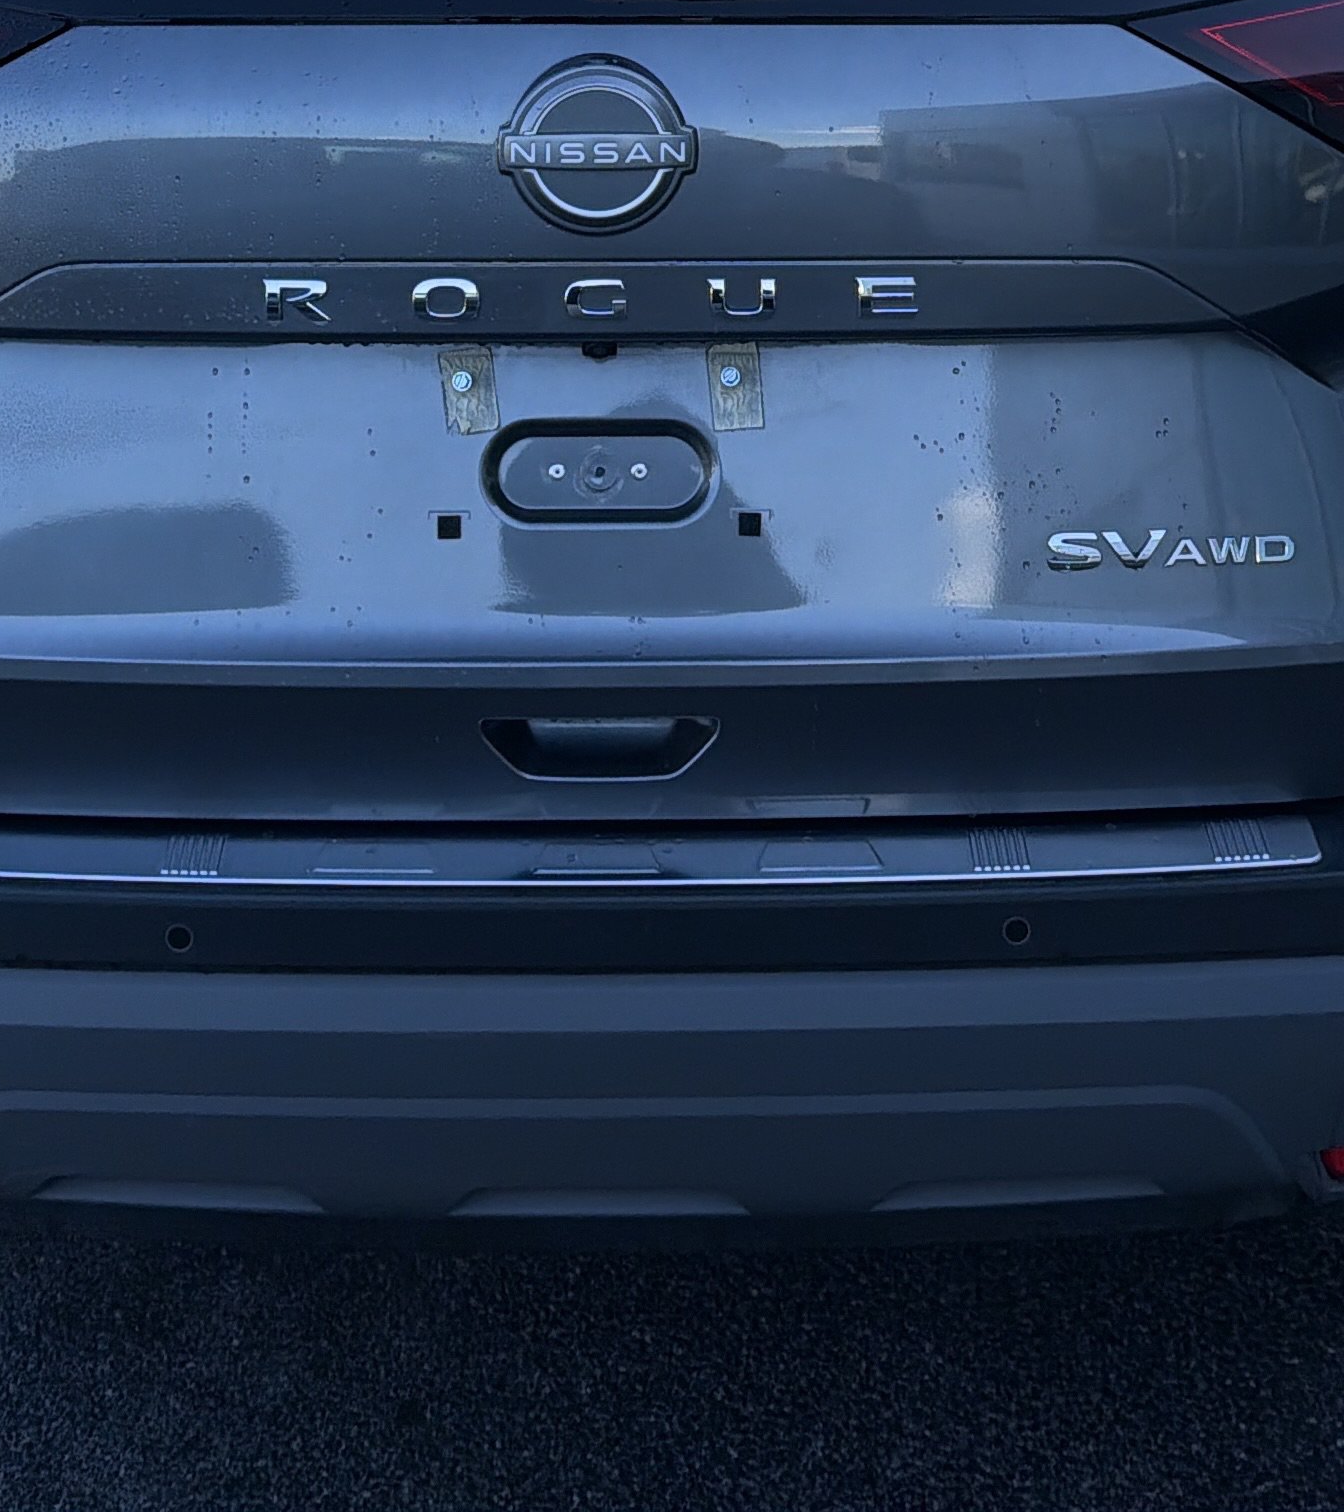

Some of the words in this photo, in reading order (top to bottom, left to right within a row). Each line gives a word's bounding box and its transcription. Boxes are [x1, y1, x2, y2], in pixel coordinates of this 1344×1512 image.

[510, 141, 686, 164] NISSAN
[262, 277, 919, 322] ROGUE
[1046, 529, 1167, 571] SV
[1164, 535, 1296, 567] AWD
